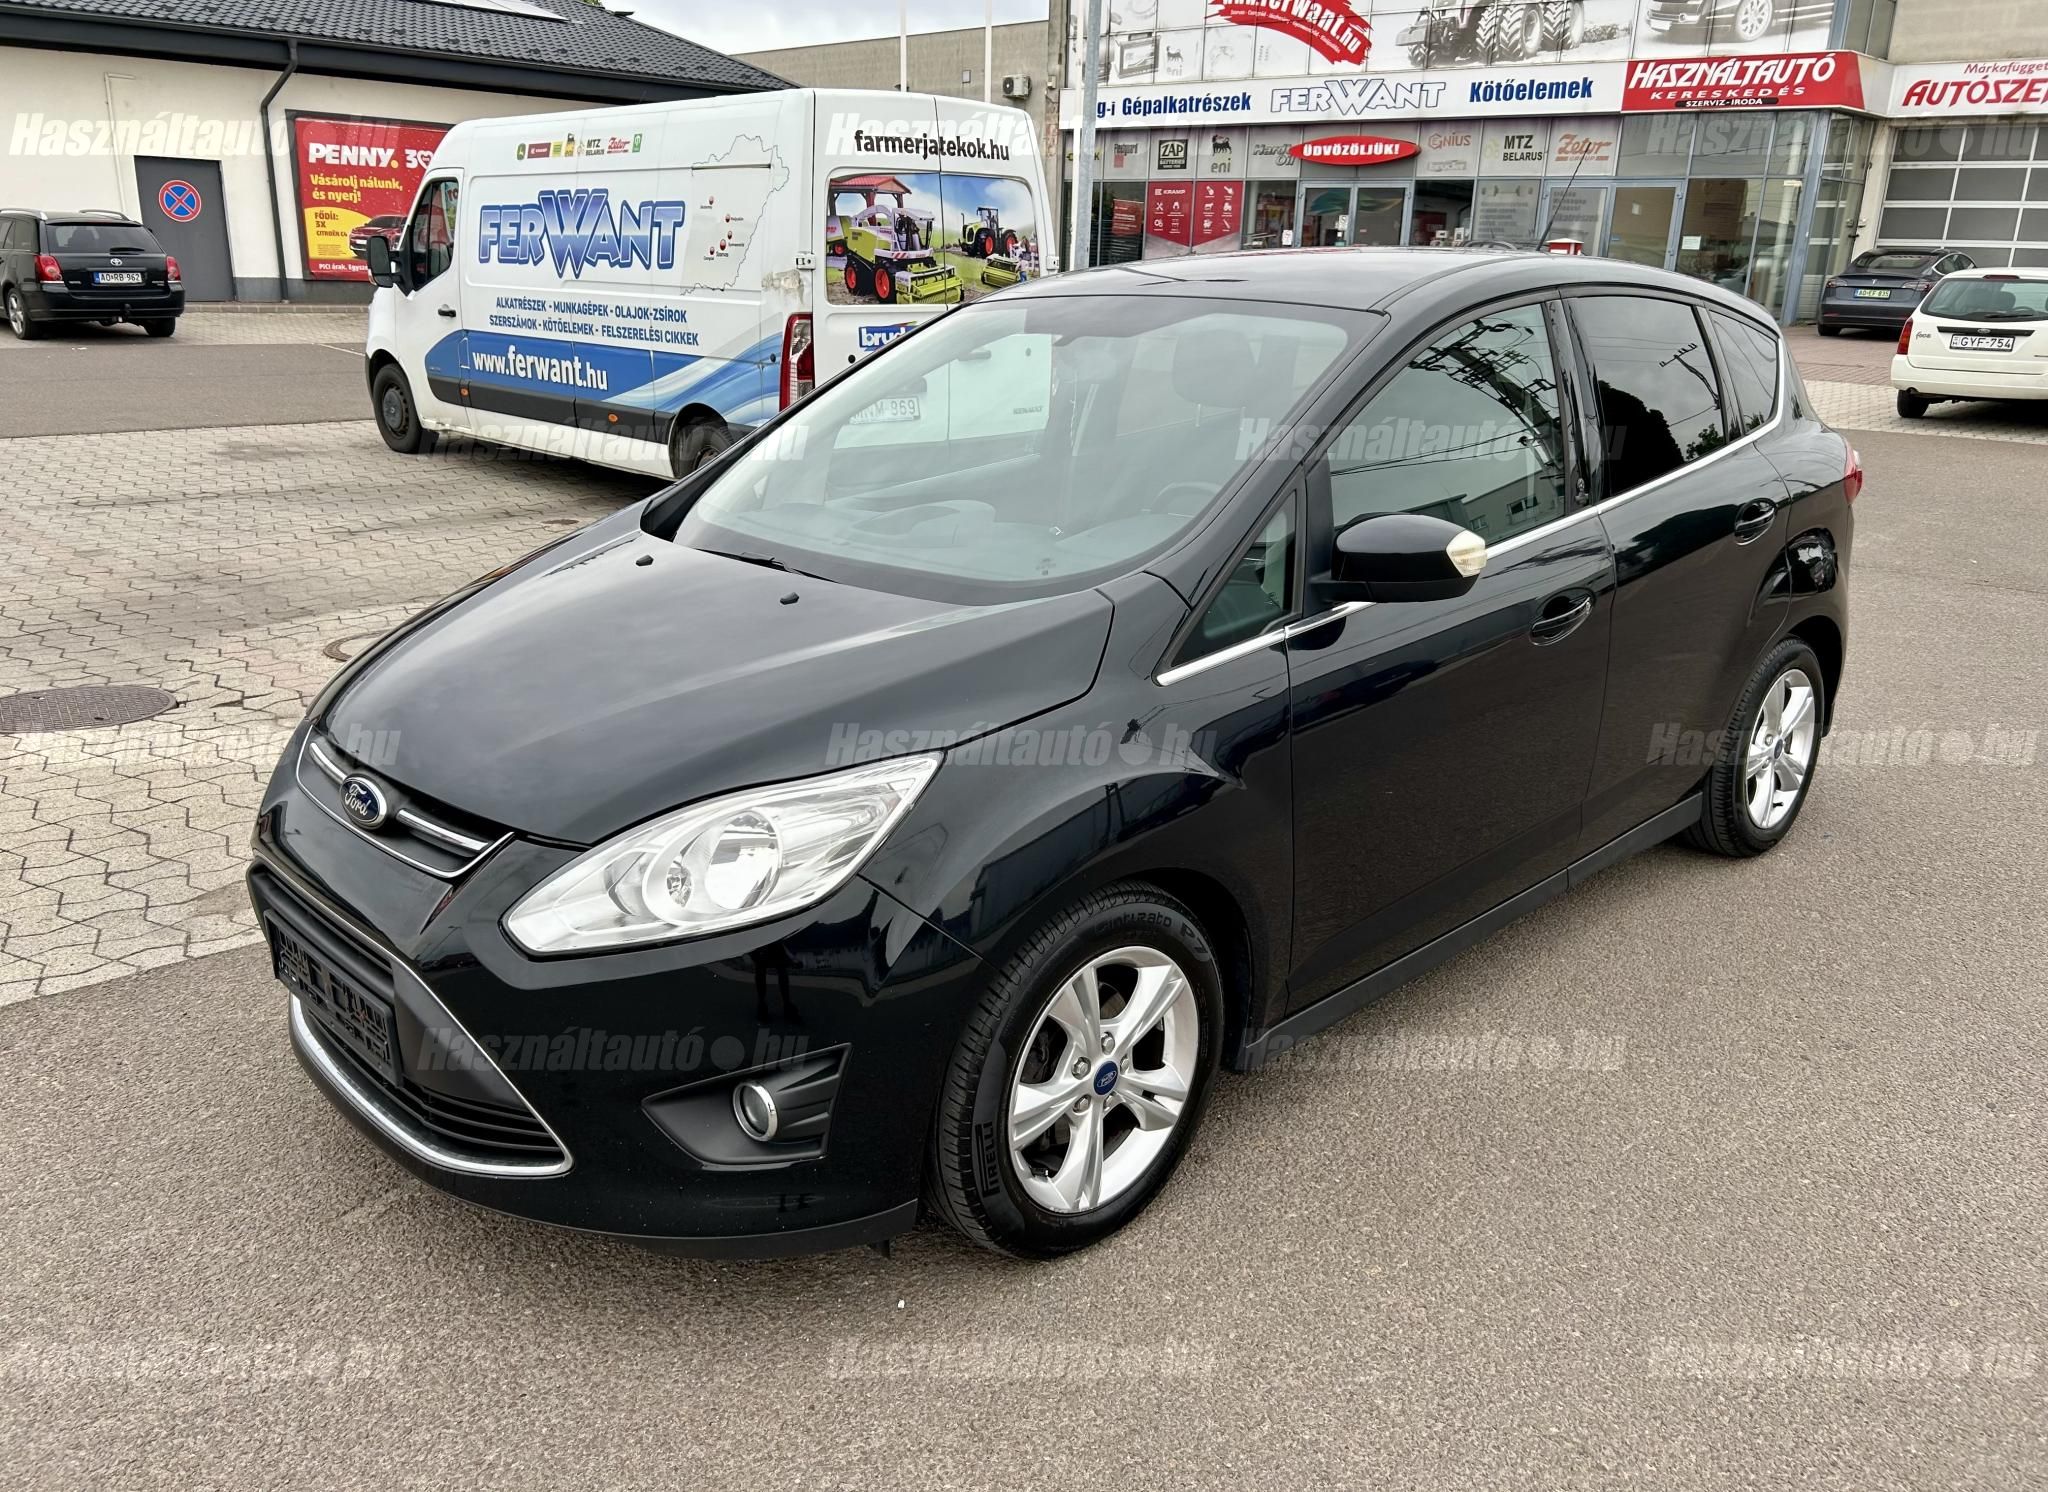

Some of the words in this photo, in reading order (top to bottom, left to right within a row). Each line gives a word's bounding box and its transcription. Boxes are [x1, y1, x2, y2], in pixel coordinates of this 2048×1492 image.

[1630, 54, 1836, 88] HASZNÁLTAUTÓ
[1271, 78, 1446, 116] FERWANT
[1469, 76, 1594, 103] Kötőelemek
[1650, 86, 1805, 100] KERESKEDÉS
[1122, 91, 1252, 117] Gépalkatrészek
[586, 138, 602, 149] MTZ
[854, 129, 1010, 161] farmerjatekok.hu
[1161, 143, 1184, 157] ZAP
[1303, 142, 1400, 157] ÜDVÖZÖLJÜK!
[1503, 135, 1534, 150] MTZ
[1210, 158, 1232, 173] eni
[1502, 151, 1544, 162] BELARUS
[310, 173, 359, 189] Vásárolj
[360, 176, 403, 191] nálunk,
[312, 187, 327, 200] és
[328, 189, 362, 203] nyerj!
[478, 188, 686, 279] FERWANT
[496, 296, 547, 312] ALKATRÉSZEK
[553, 299, 609, 318] MUNKAGÉPEK
[489, 314, 538, 331] SZERSZÁMOK
[542, 316, 594, 336] KÖTŐELEMEK
[601, 323, 664, 343] FELSZERELÉSI
[664, 331, 699, 346] CIKKEK
[1960, 336, 2012, 349] GYF-754
[472, 345, 608, 392] www.ferwant.hu
[344, 783, 371, 816] Ford
[975, 1121, 1001, 1198] PIRELLI
